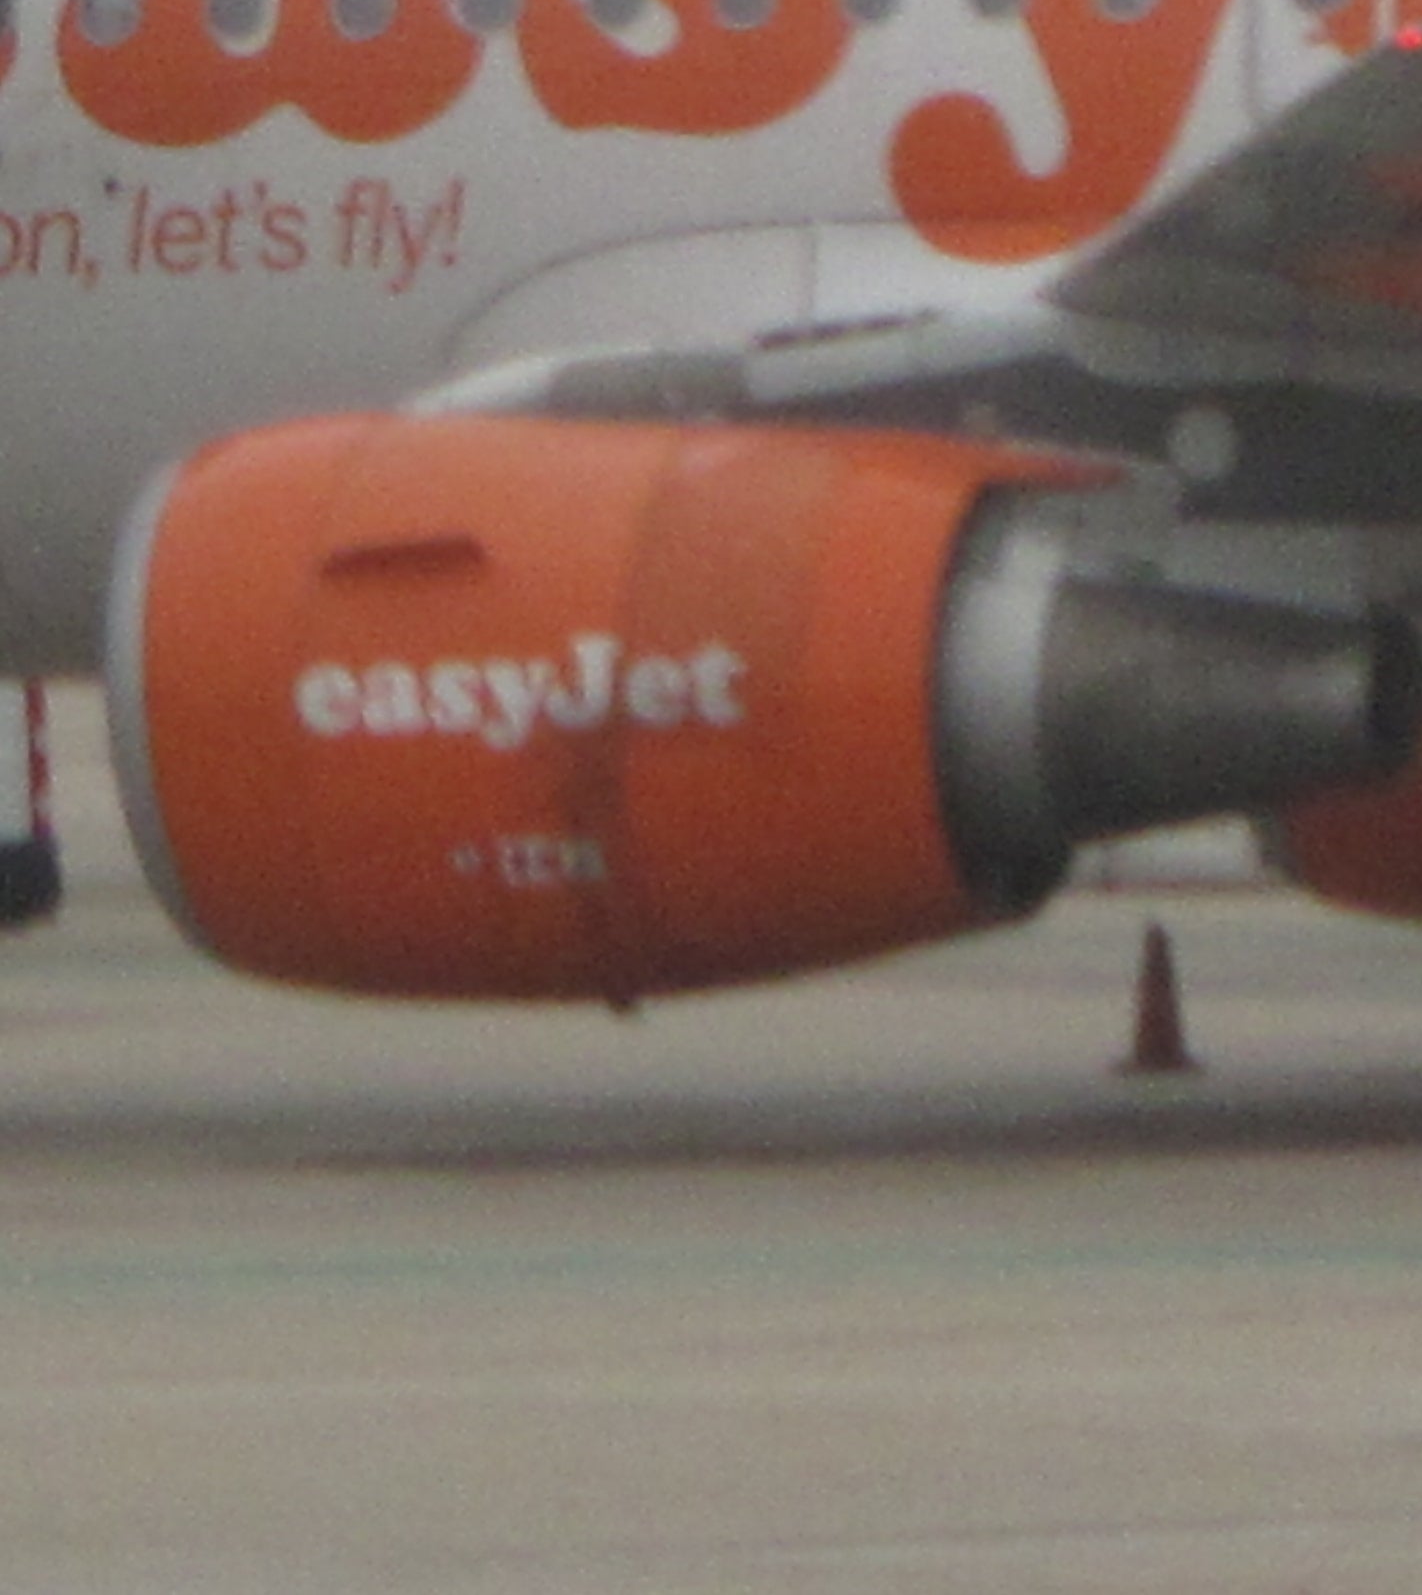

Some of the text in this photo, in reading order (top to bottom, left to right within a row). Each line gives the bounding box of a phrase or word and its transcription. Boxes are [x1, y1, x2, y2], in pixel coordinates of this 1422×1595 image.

[131, 182, 308, 274] let's
[338, 173, 464, 294] fly!
[295, 632, 747, 751] easyJet
